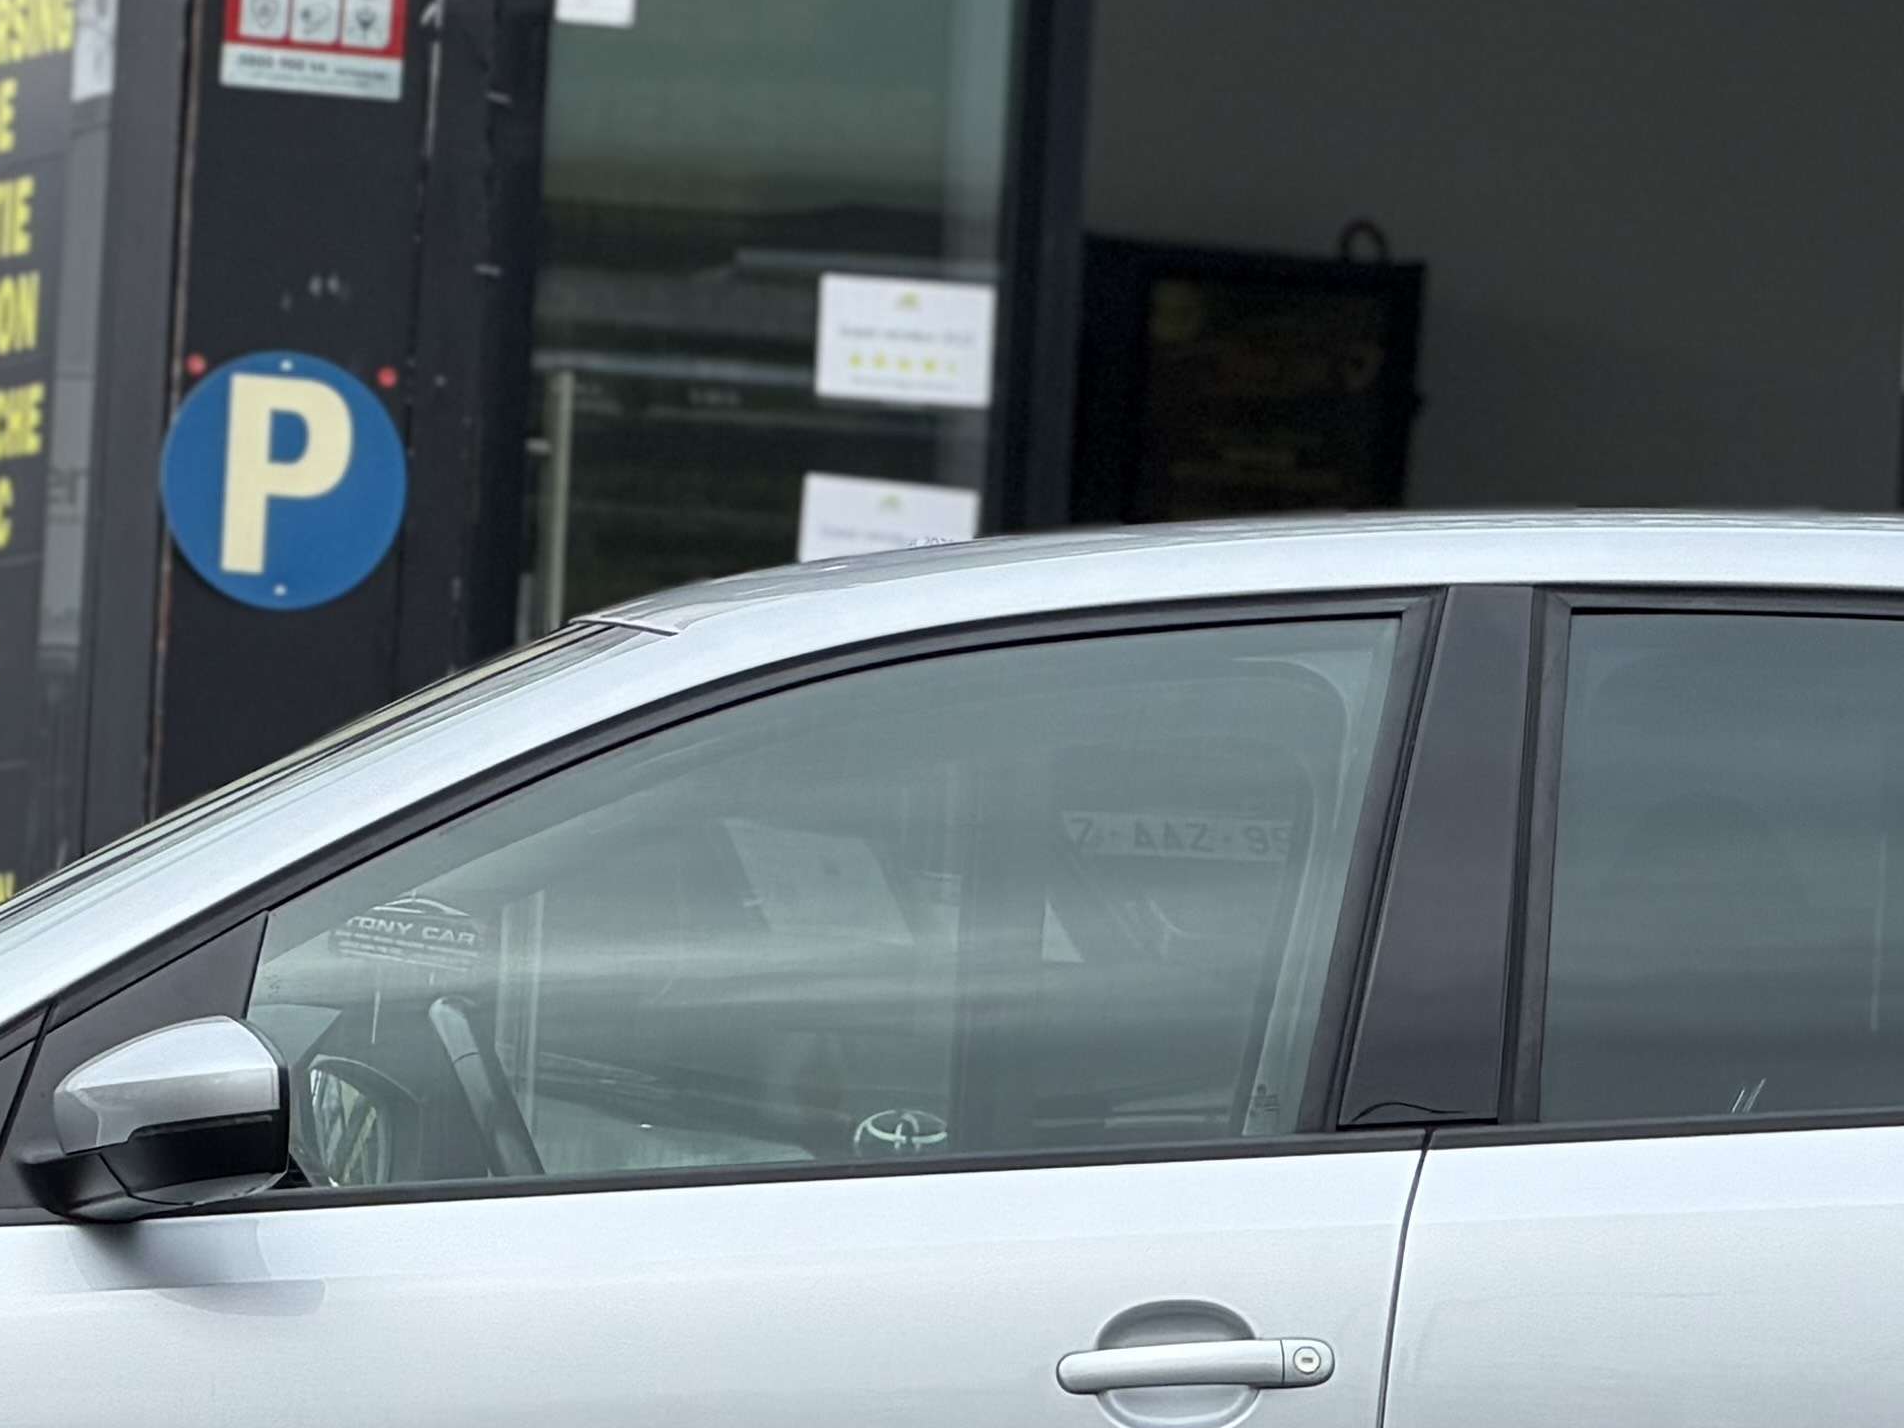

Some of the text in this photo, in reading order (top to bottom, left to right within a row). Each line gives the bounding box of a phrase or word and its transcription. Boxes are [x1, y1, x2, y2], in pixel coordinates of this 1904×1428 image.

[220, 371, 354, 575] P
[346, 915, 476, 948] TONY CAR
